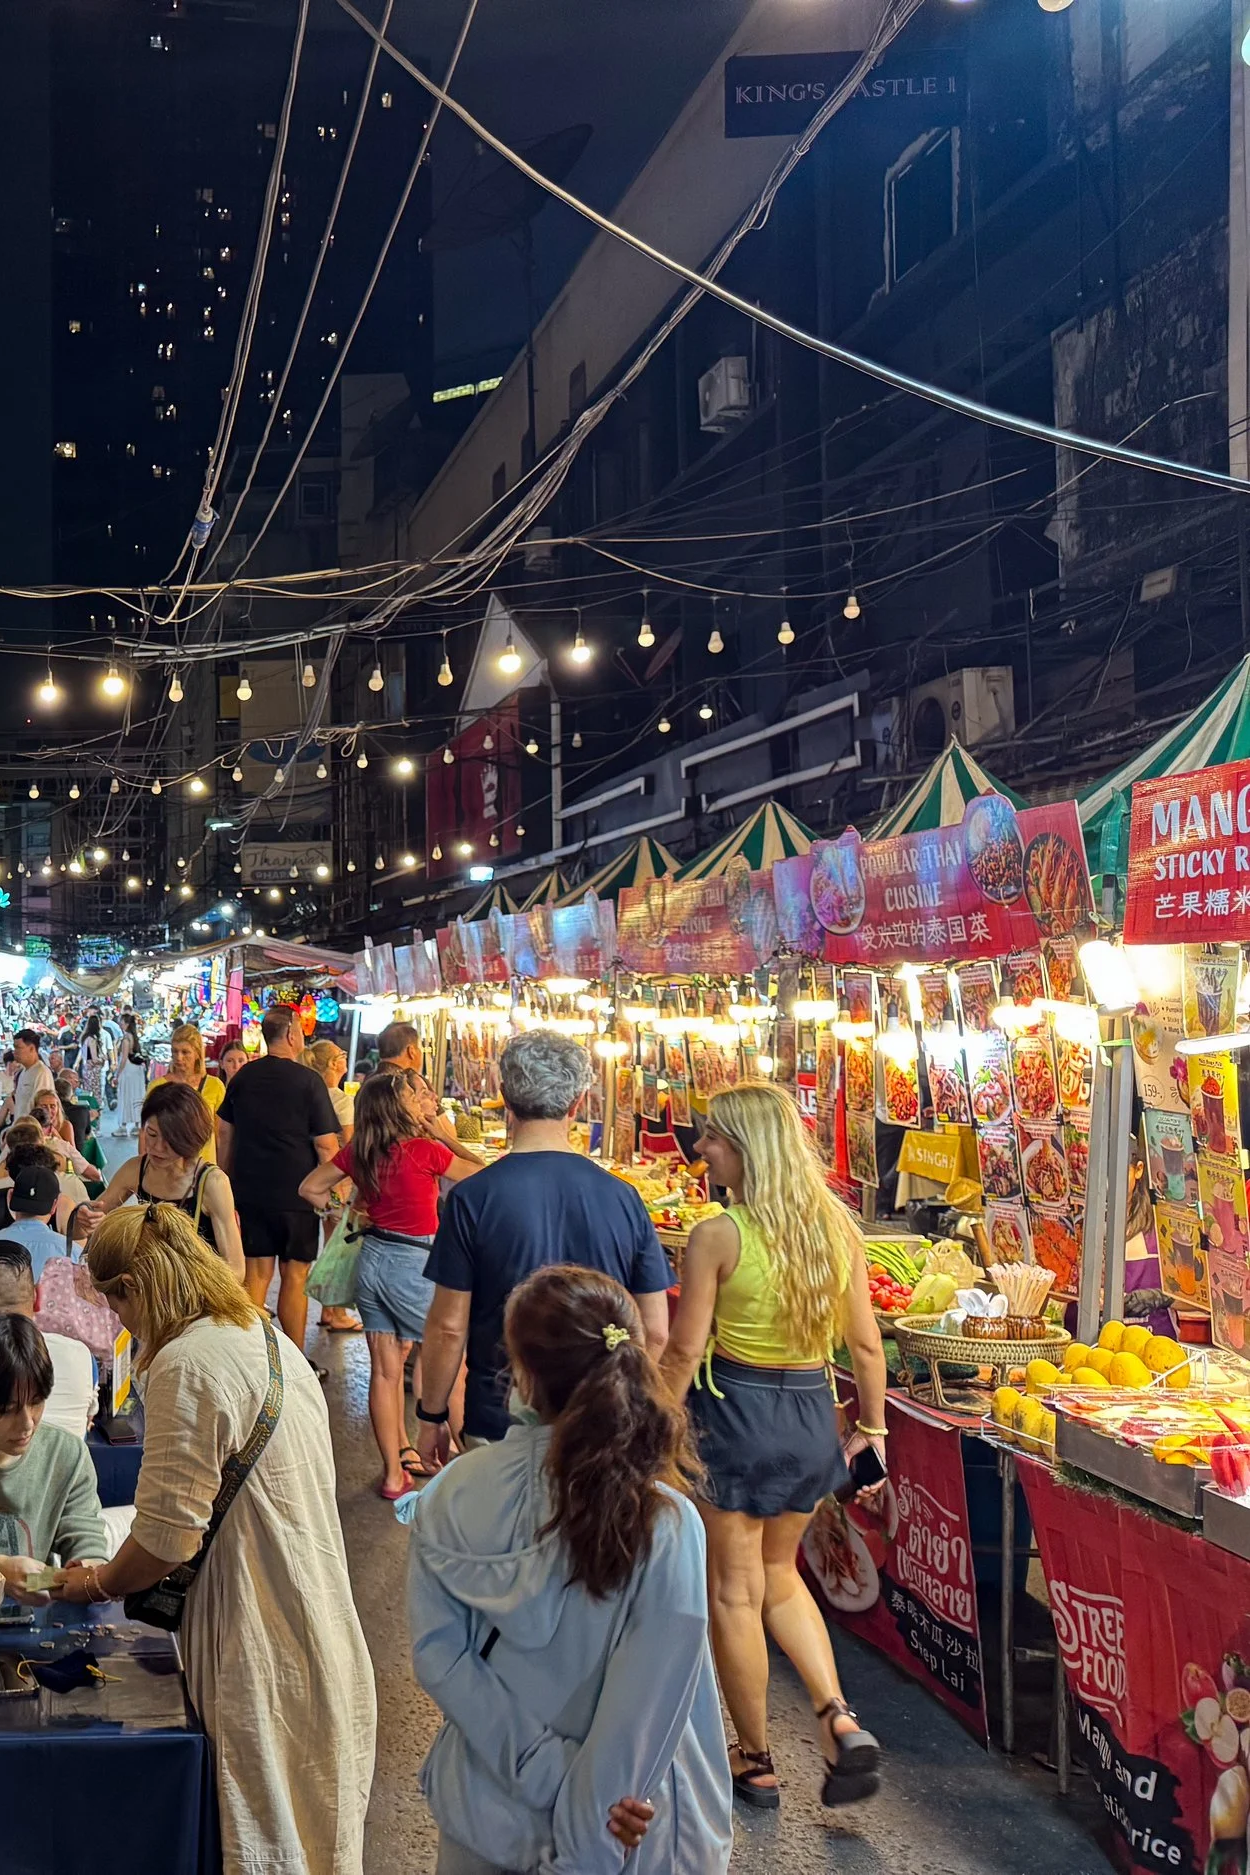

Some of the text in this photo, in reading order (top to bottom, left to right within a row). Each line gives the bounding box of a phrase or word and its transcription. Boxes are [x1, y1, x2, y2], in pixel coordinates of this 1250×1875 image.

[735, 83, 826, 104] KING'S
[840, 77, 937, 99] ASTLE
[860, 840, 963, 881] POPULAR THAI
[1154, 847, 1228, 881] STICKY
[885, 881, 943, 913] CUISINE
[1049, 1579, 1127, 1658] STREE
[941, 1658, 964, 1692] Lai
[1081, 1645, 1127, 1701] FOOD
[1114, 1759, 1158, 1802] and
[1131, 1826, 1181, 1867] rice
